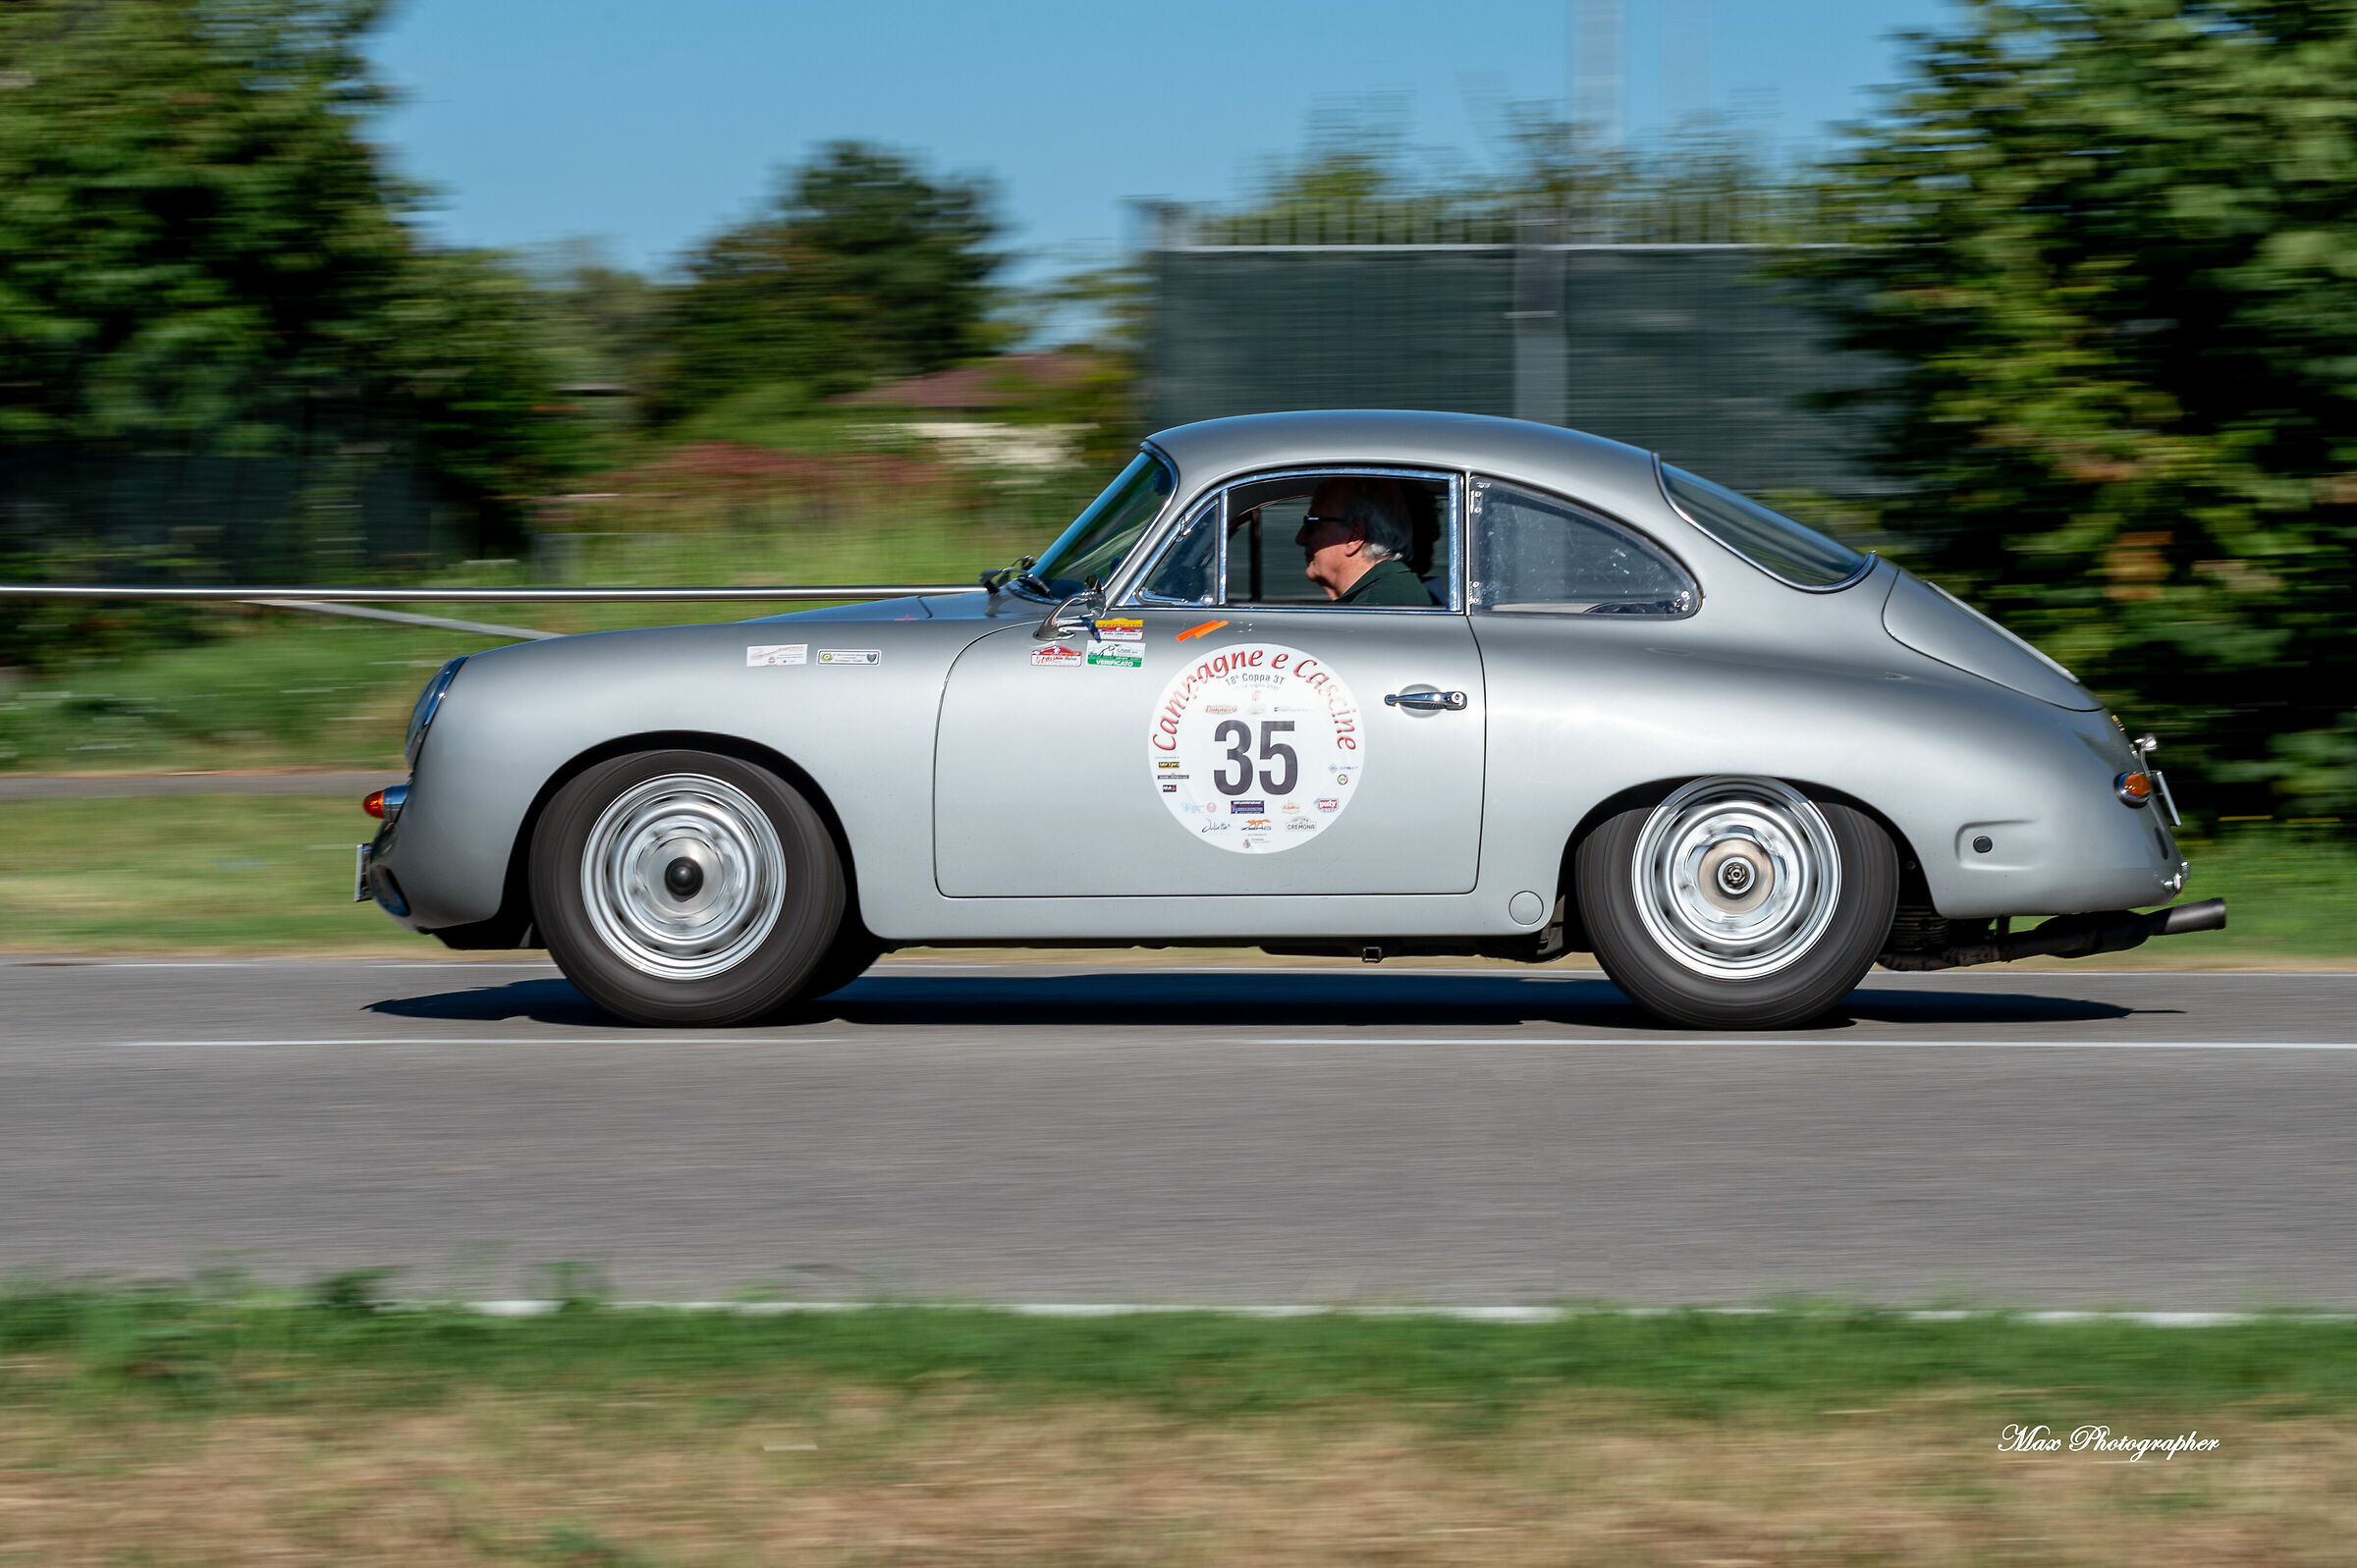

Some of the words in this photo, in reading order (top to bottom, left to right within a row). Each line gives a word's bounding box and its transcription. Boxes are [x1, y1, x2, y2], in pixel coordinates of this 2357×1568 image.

[1152, 649, 1263, 751] Campagne
[1271, 653, 1288, 670] e
[1292, 659, 1356, 750] Cascine
[1241, 673, 1270, 682] Coppa
[1213, 719, 1298, 796] 35
